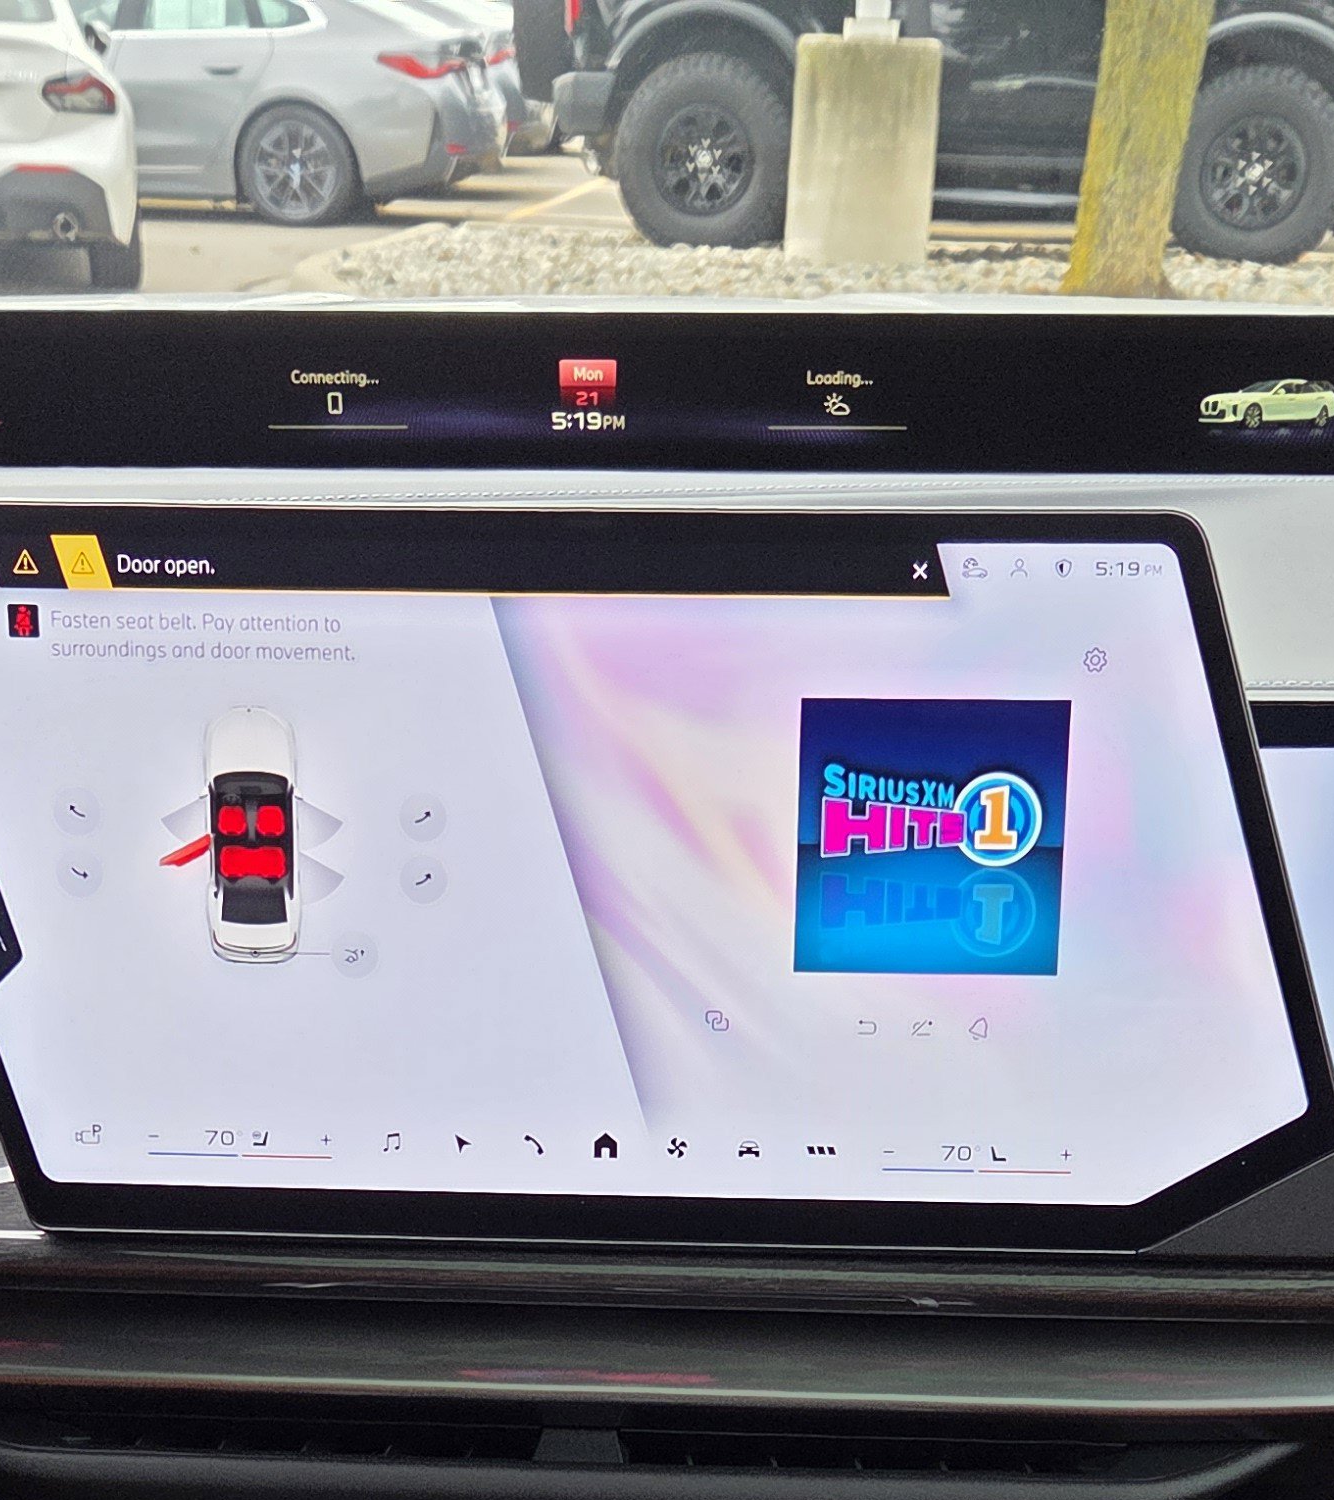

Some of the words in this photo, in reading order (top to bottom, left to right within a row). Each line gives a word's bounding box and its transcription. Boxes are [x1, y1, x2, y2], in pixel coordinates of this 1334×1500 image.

[290, 369, 380, 387] Connecting...
[573, 366, 604, 382] Mon
[806, 370, 874, 388] Loading...
[575, 391, 599, 406] 21
[117, 554, 162, 574] Door
[165, 556, 216, 577] open.
[50, 610, 111, 629] Fasten
[116, 612, 155, 631] seat
[159, 612, 197, 631] belt.
[202, 613, 234, 635] Pay
[239, 614, 319, 632] attention
[323, 616, 342, 633] to
[50, 641, 167, 661] surroundings
[171, 640, 205, 659] and
[210, 641, 251, 660] door
[255, 643, 357, 662] movement.
[973, 785, 1018, 850] 1
